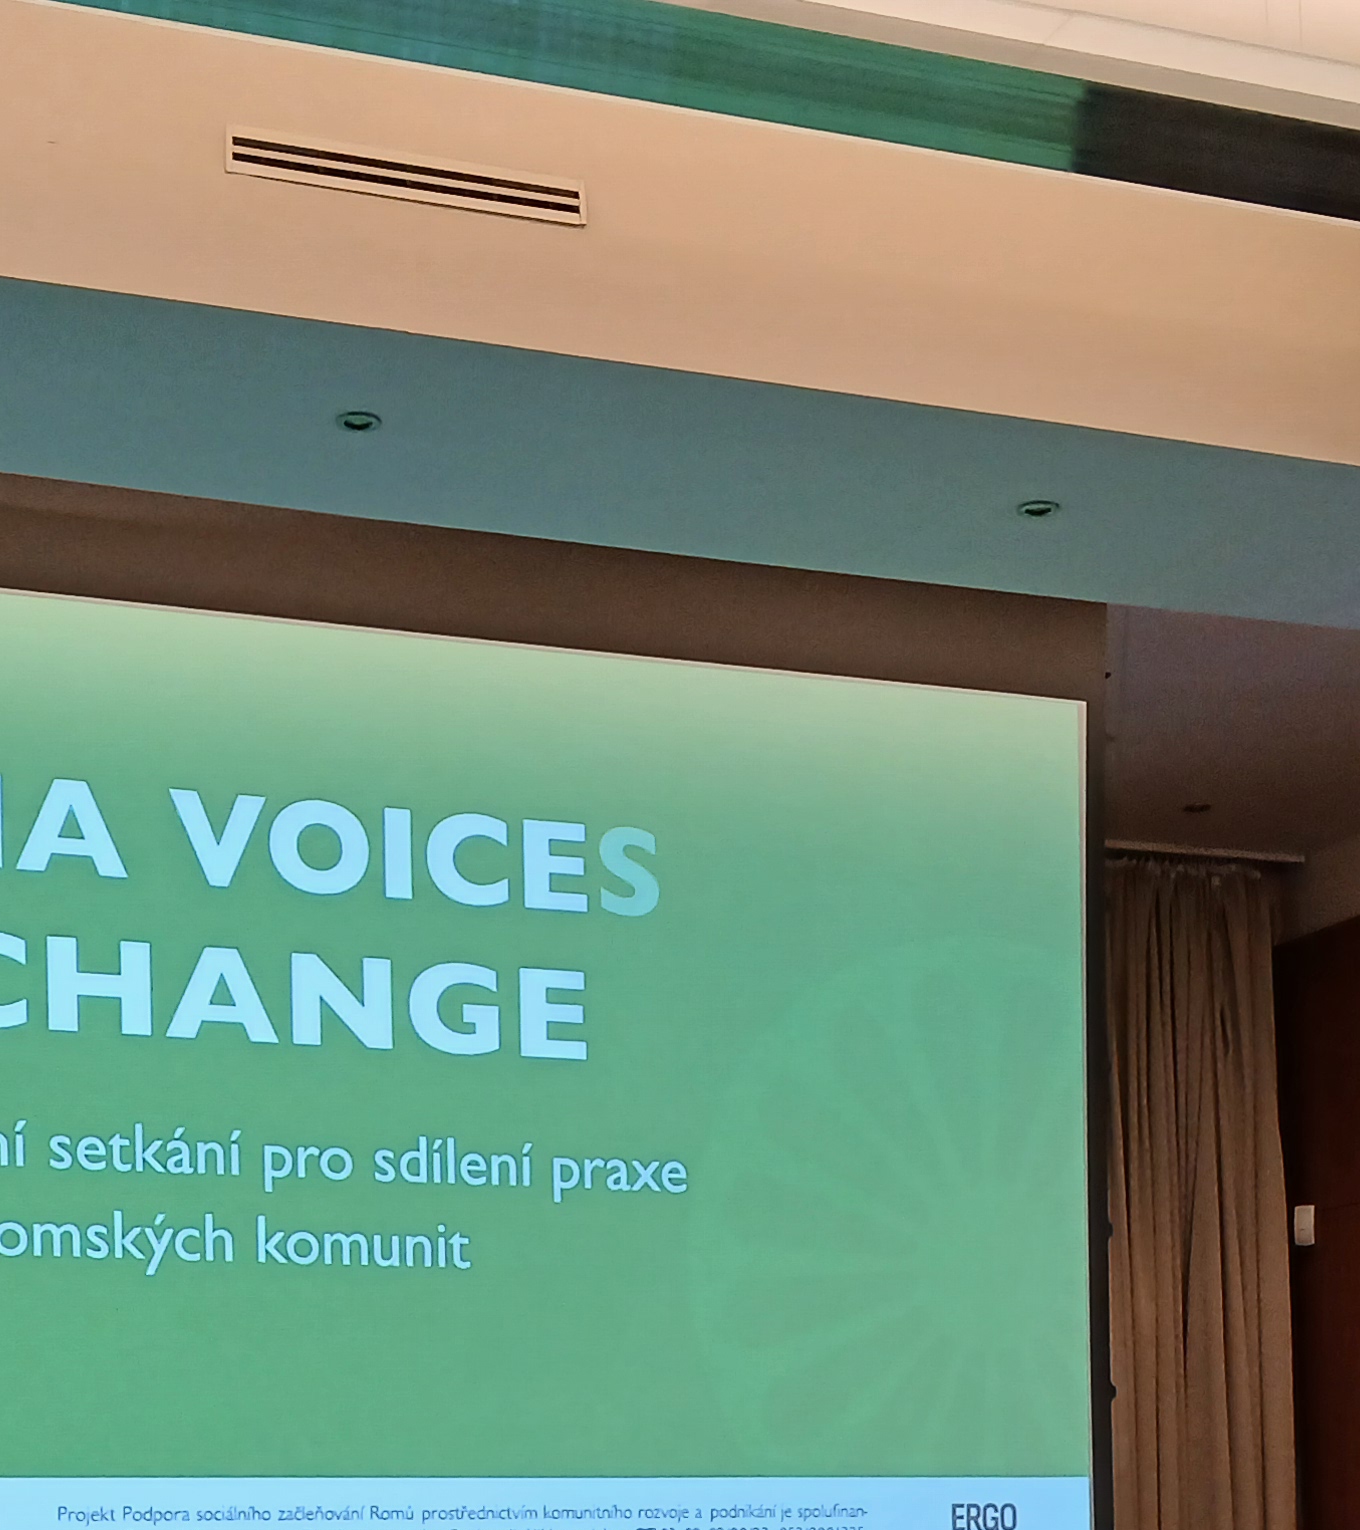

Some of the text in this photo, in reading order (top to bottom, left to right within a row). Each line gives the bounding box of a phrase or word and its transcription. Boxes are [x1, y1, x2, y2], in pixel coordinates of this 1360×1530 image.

[169, 789, 659, 916] VOICES
[50, 1123, 241, 1175] setkání
[264, 1145, 352, 1192] pro
[375, 1136, 532, 1186] sdílení
[553, 1158, 687, 1202] praxe
[258, 1216, 470, 1269] komunit
[58, 1506, 115, 1526] Projekt
[123, 1506, 190, 1526] Podpora
[197, 1506, 271, 1521] sociálního
[370, 1506, 413, 1520] Romů
[422, 1505, 537, 1524] prostřednictvím
[543, 1505, 632, 1519] komunitního
[638, 1505, 690, 1523] rozvoje
[695, 1508, 702, 1518] a
[711, 1505, 775, 1522] podnikání
[780, 1504, 792, 1523] je
